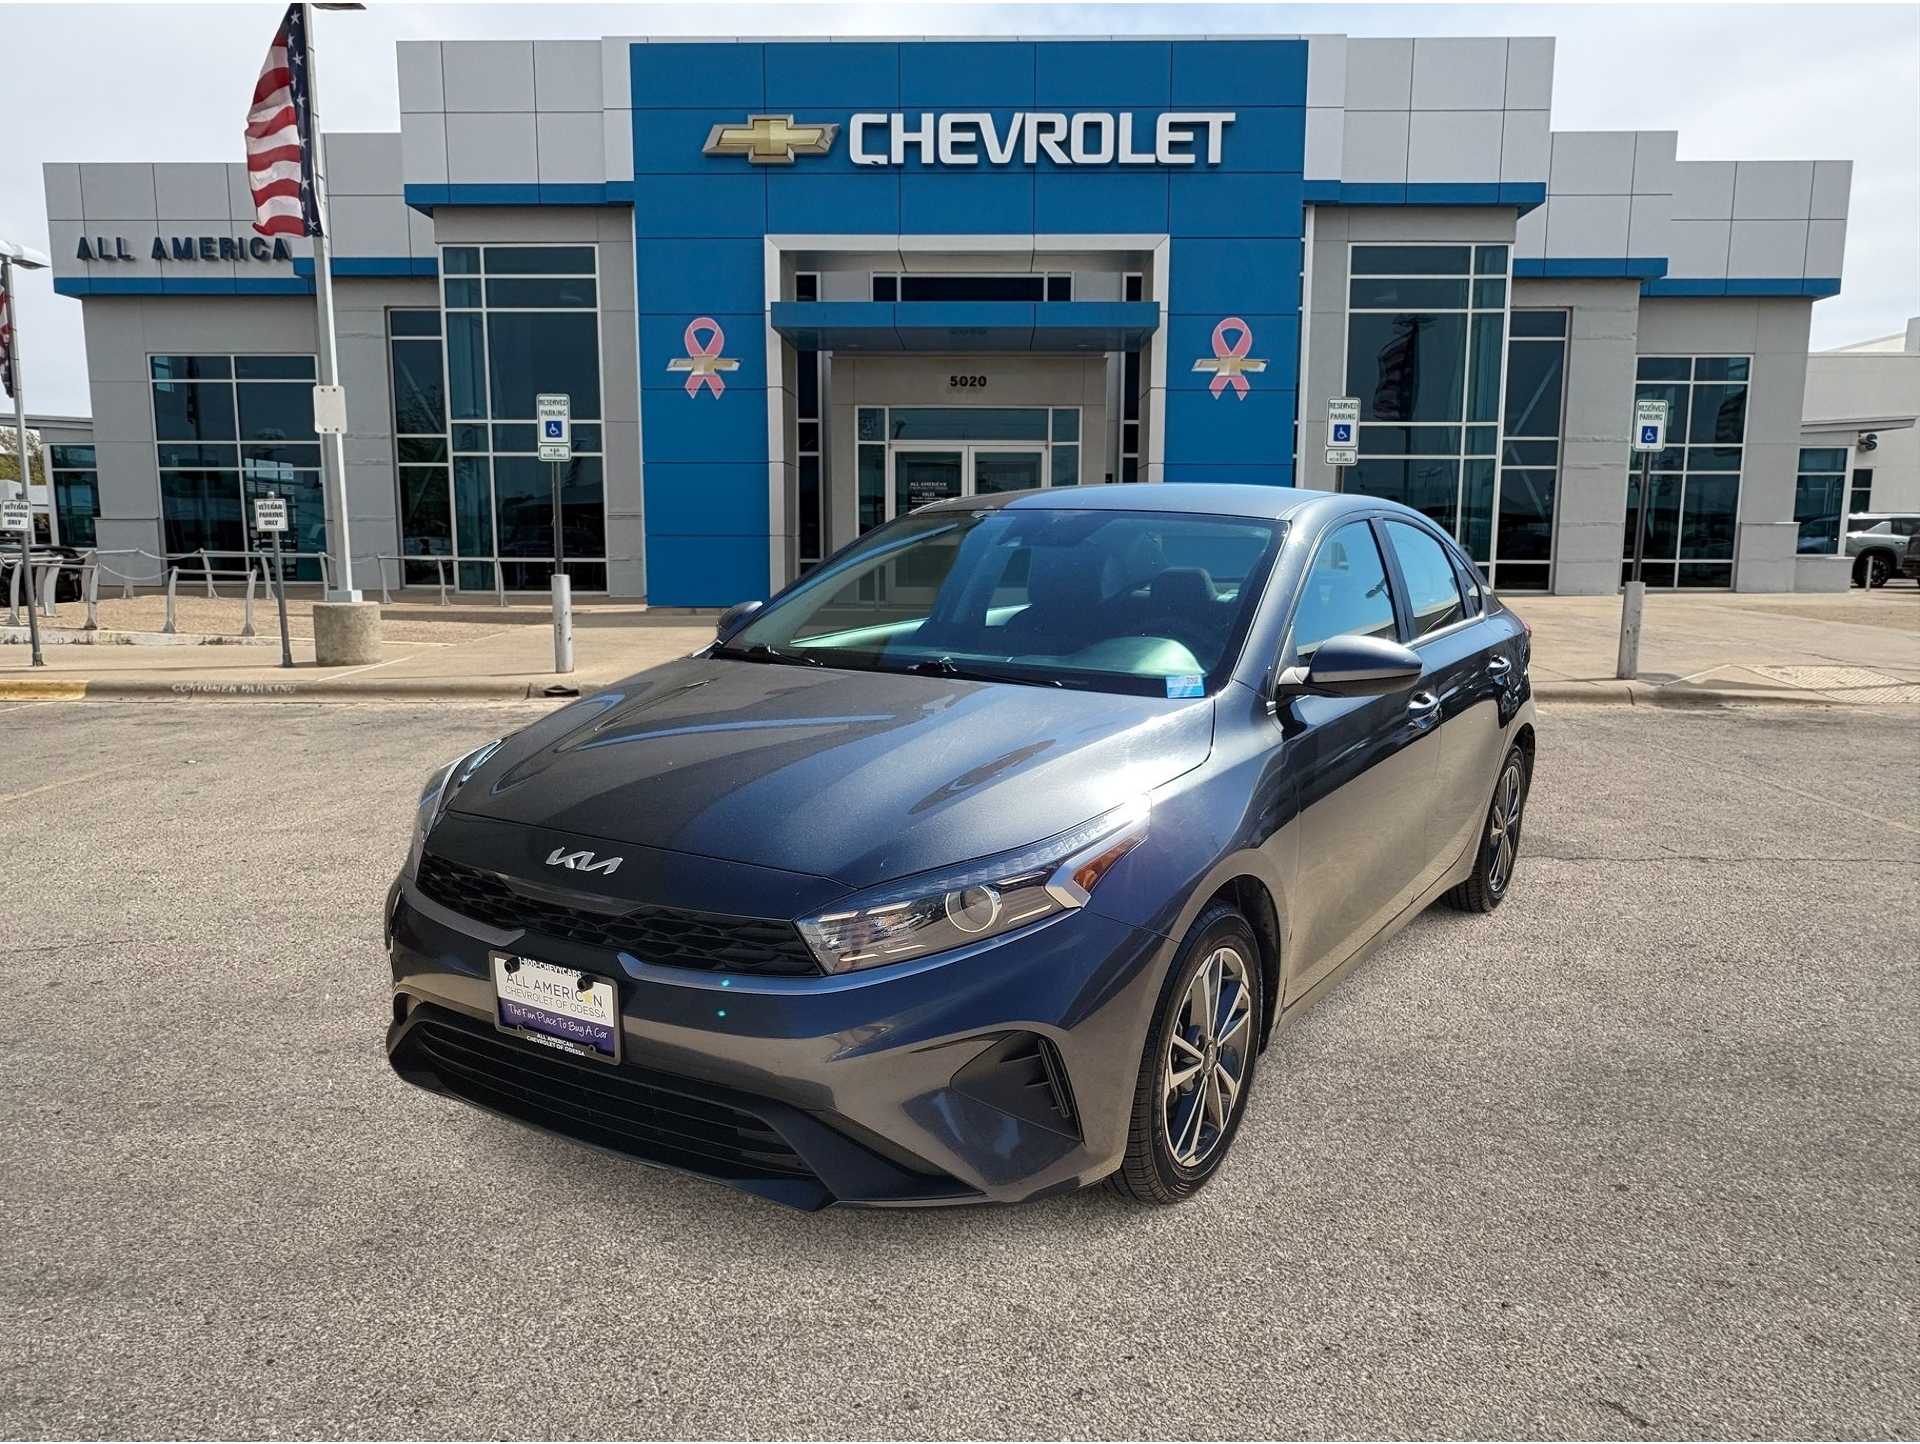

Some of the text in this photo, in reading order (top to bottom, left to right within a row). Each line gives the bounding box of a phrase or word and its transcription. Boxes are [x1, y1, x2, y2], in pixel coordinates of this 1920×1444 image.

[848, 112, 1237, 166] CHEVROLET
[76, 236, 293, 262] ALL AMERICA
[949, 375, 987, 388] 5020
[541, 409, 567, 417] PARKING
[1330, 412, 1356, 420] PARKING
[1639, 413, 1663, 421] PARKING
[545, 846, 624, 875] KIA
[505, 985, 606, 1019] CHEVROLET OF ODESSA
[506, 974, 602, 1008] ALL AMERICN
[507, 1003, 608, 1039] The Fun Place To Buy A Car
[526, 1035, 556, 1048] CHEVROLET
[564, 1046, 586, 1056] ODESSA
[547, 1036, 574, 1048] AMERICAN
